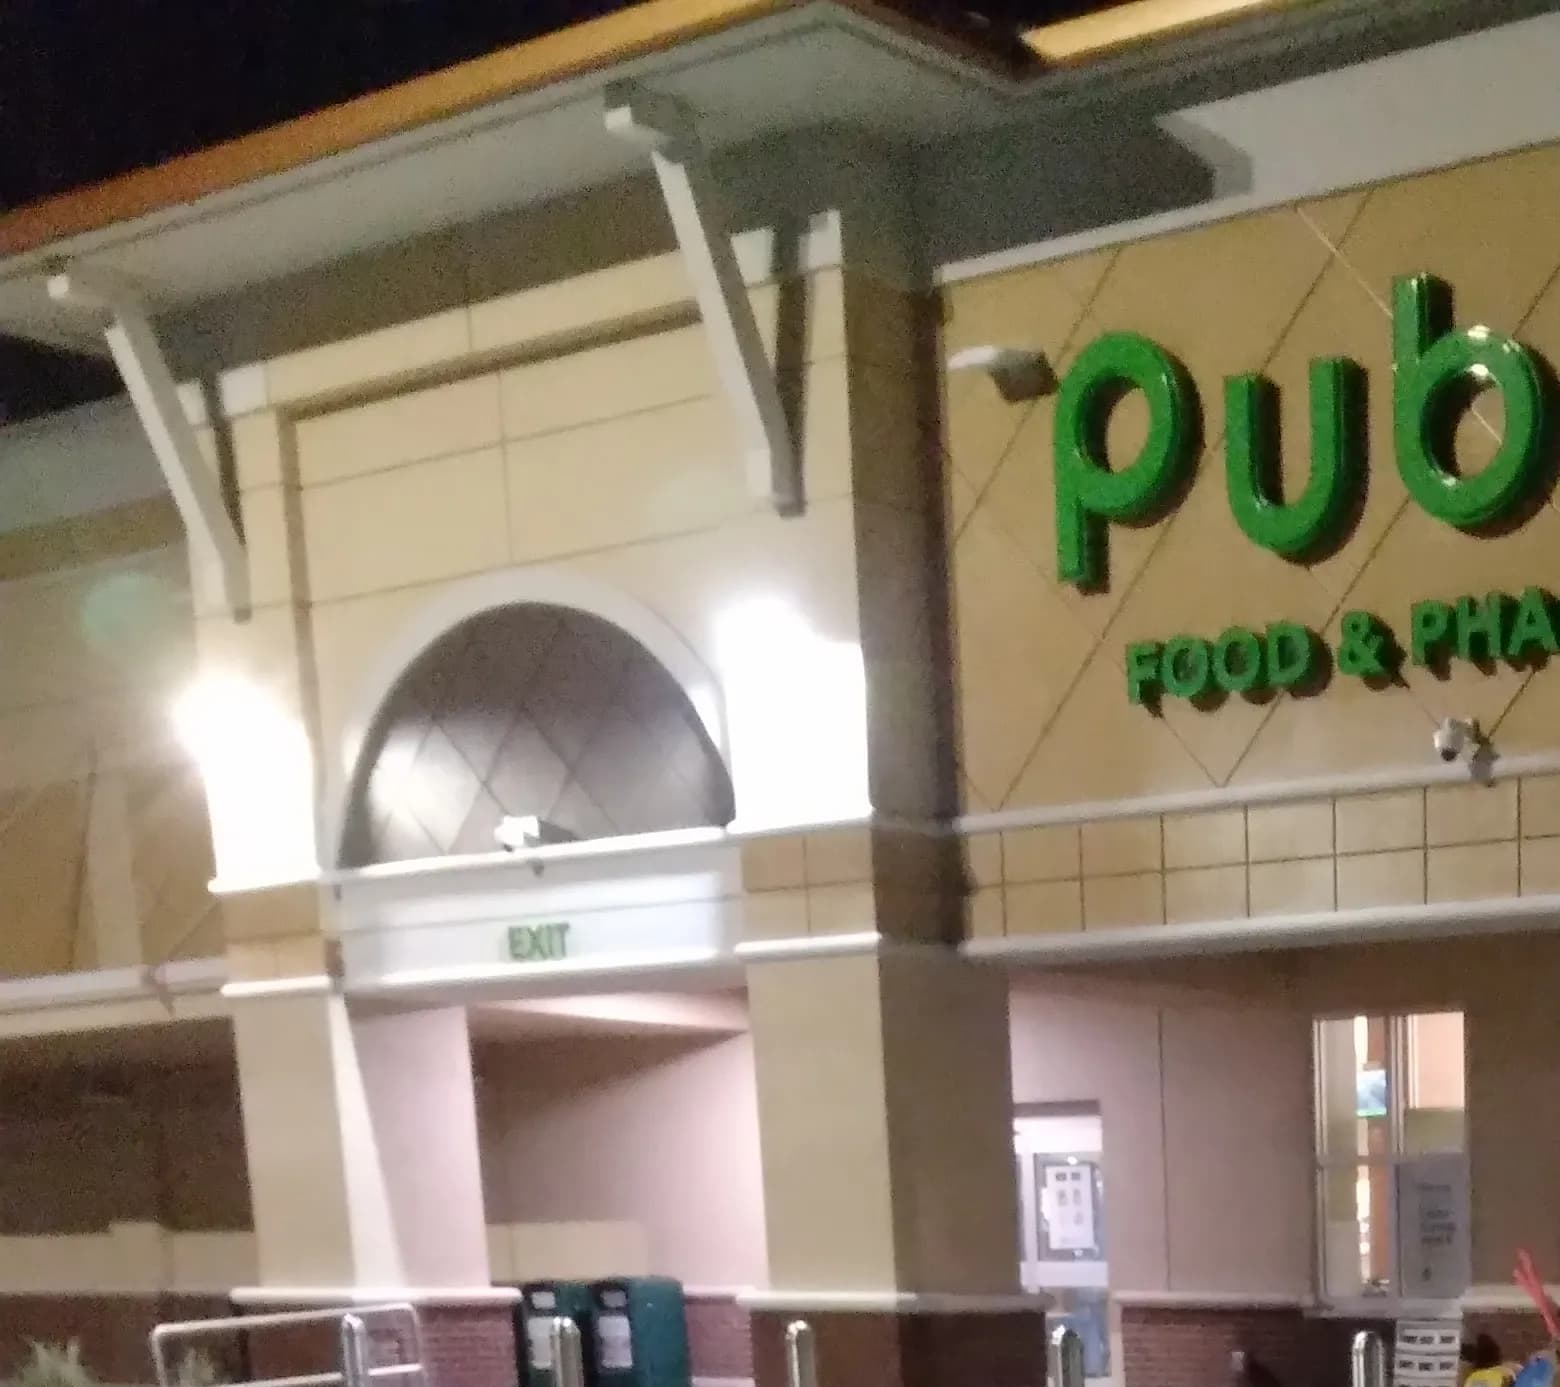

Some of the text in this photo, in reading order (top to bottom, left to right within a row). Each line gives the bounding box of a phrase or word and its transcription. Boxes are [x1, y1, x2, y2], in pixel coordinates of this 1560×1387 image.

[1126, 621, 1312, 705] FOOD
[1336, 611, 1386, 679] &
[508, 922, 570, 961] EXIT
